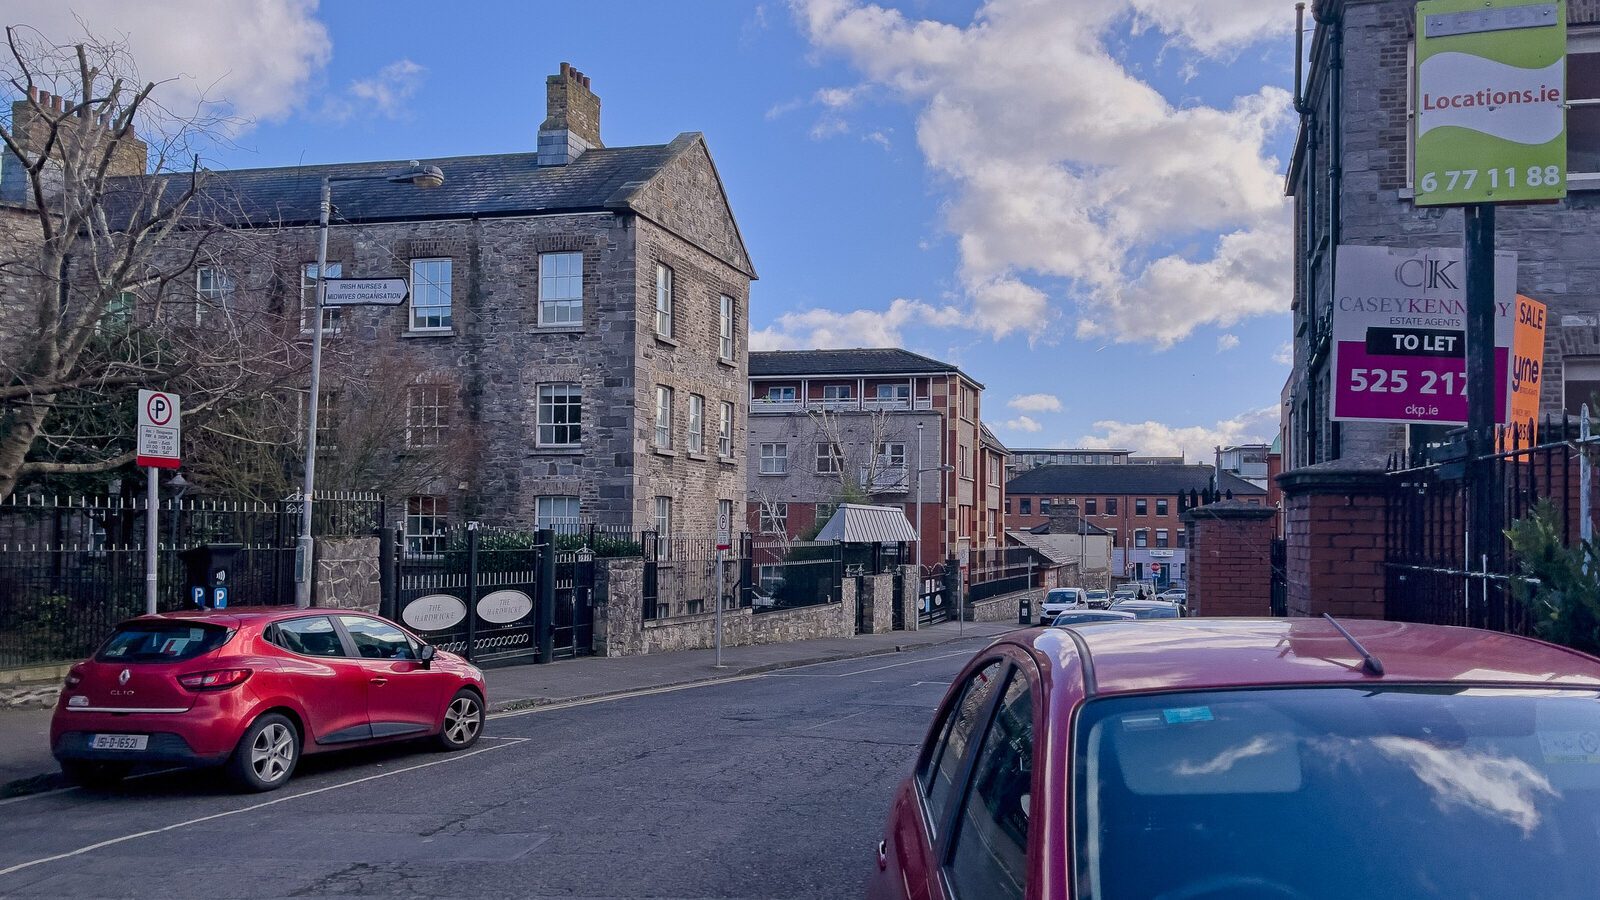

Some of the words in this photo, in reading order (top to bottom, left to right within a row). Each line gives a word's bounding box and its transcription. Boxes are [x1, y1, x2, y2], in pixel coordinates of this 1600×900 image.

[1423, 85, 1560, 111] Locations.ie
[1421, 171, 1438, 192] 6
[1445, 169, 1478, 191] 77
[1487, 167, 1515, 188] 11
[1526, 165, 1560, 187] 88
[1390, 317, 1423, 326] ESTATE
[1424, 318, 1461, 327] AGENTS
[1519, 302, 1543, 330] SALE
[1392, 334, 1419, 350] TO
[1423, 335, 1457, 352] LET
[1350, 368, 1408, 393] 525
[1512, 355, 1539, 393] yrne
[156, 400, 165, 419] P
[1405, 404, 1439, 417] ckp.ie
[194, 588, 204, 603] P
[216, 590, 225, 606] P
[414, 612, 455, 622] HARDWICKE
[486, 605, 522, 616] HARDWICKE
[96, 737, 138, 748] 151-D-16521
